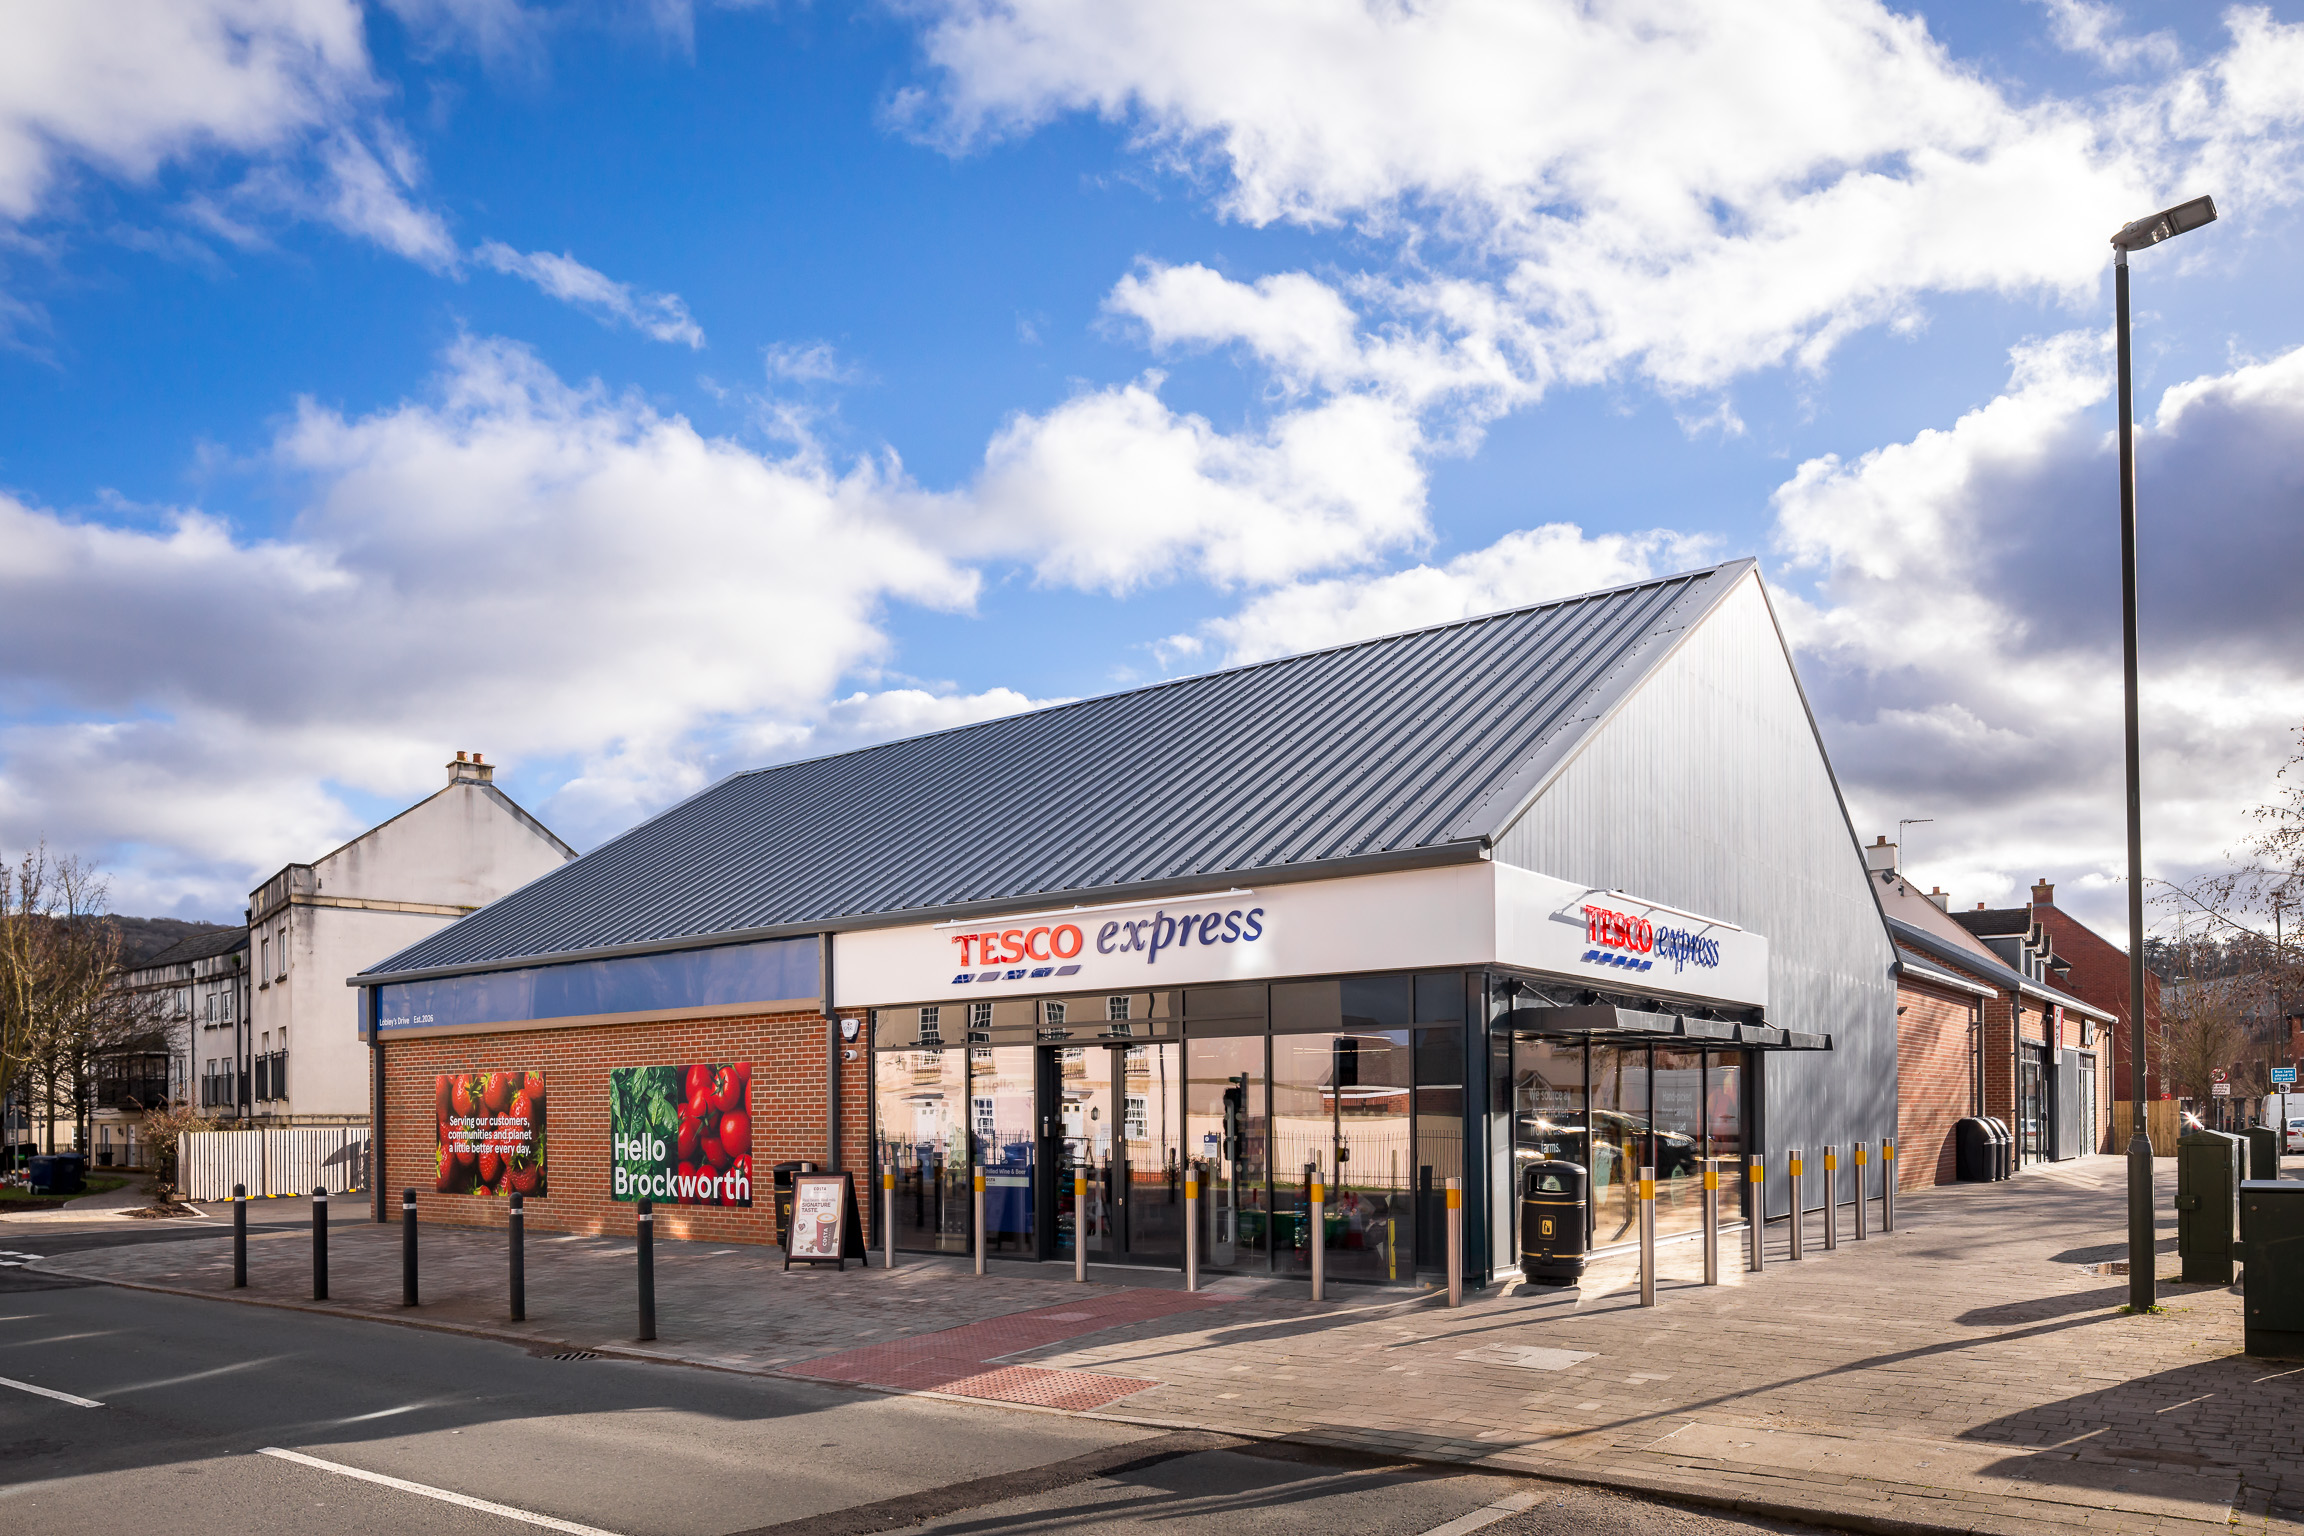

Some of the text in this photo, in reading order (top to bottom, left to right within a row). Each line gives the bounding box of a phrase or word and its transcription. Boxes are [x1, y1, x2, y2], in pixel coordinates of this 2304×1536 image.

[952, 908, 1264, 967] TESCO express
[1585, 905, 1719, 972] TESCO express
[379, 1017, 397, 1027] Lobley's
[397, 1016, 410, 1025] Drive
[983, 1078, 1018, 1093] Hello.
[1529, 1088, 1540, 1100] We
[1541, 1089, 1563, 1101] source
[449, 1115, 530, 1129] Serving our customers,
[448, 1129, 532, 1142] communities and planet
[448, 1142, 531, 1156] a little better every day.
[614, 1132, 666, 1162] Hello
[615, 1166, 750, 1200] Brockworth
